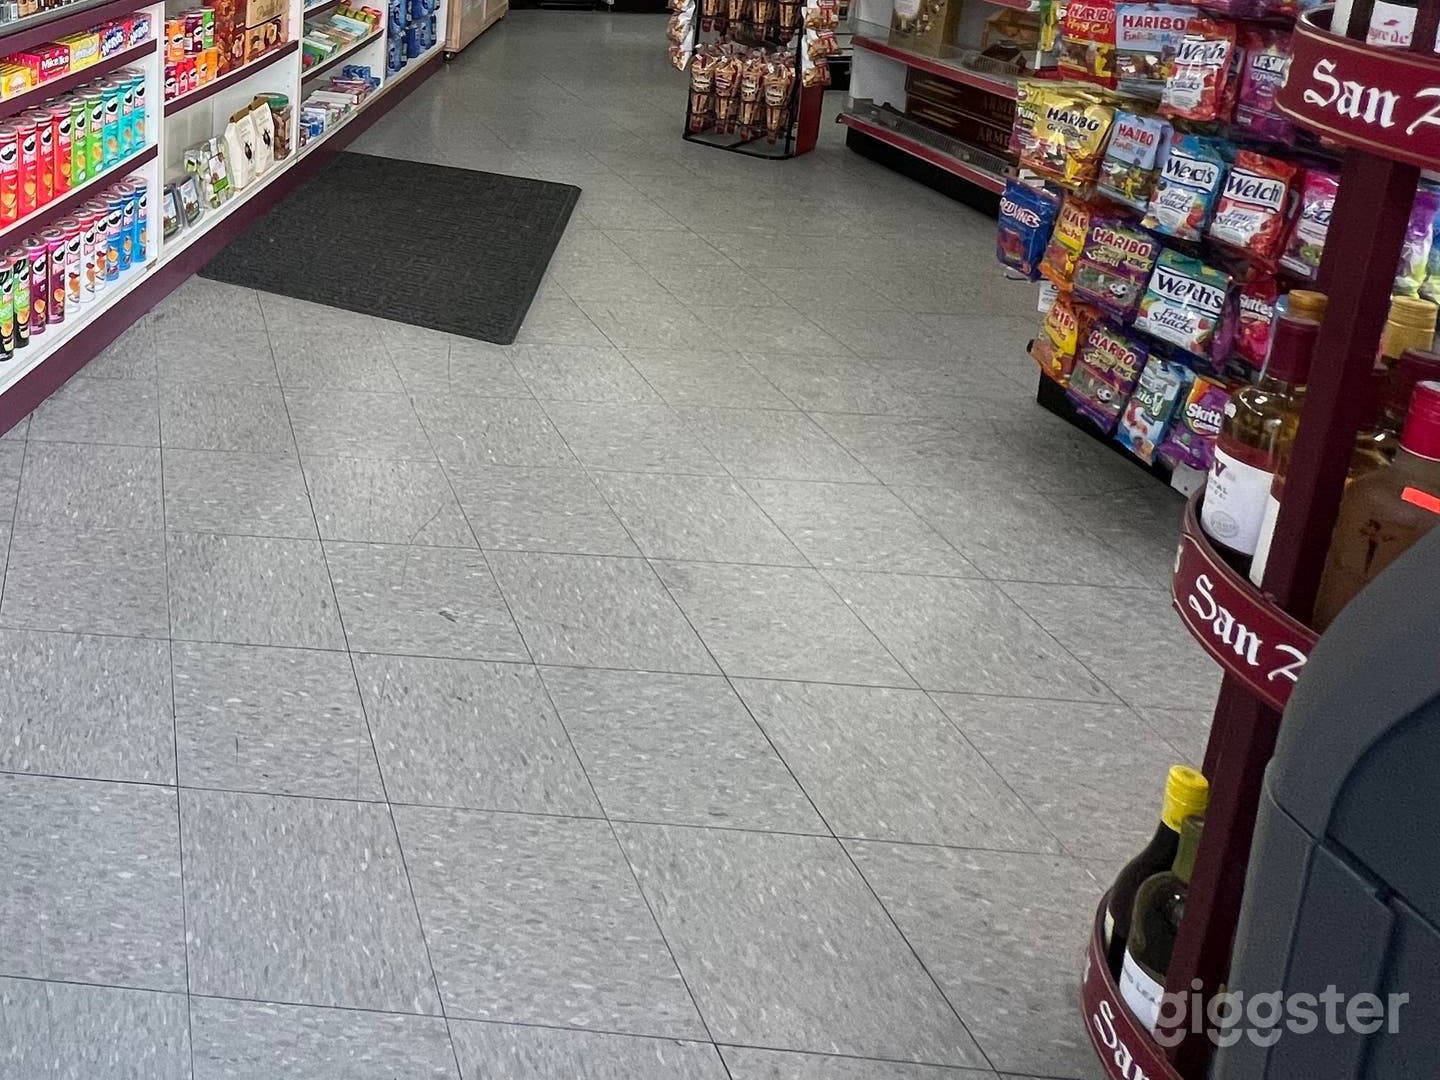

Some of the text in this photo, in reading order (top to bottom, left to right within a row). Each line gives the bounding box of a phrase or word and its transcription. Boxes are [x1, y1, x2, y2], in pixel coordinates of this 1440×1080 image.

[1123, 14, 1185, 31] HARIBO
[1303, 58, 1400, 129] San
[1047, 107, 1100, 132] HARIBO
[1227, 174, 1283, 204] Welch'
[1094, 226, 1151, 257] HARIBO
[1151, 311, 1196, 335] Snacks
[1162, 307, 1190, 323] Fruit
[1089, 330, 1136, 367] HARIBO
[1186, 403, 1222, 425] Skitt
[1188, 574, 1263, 667] San
